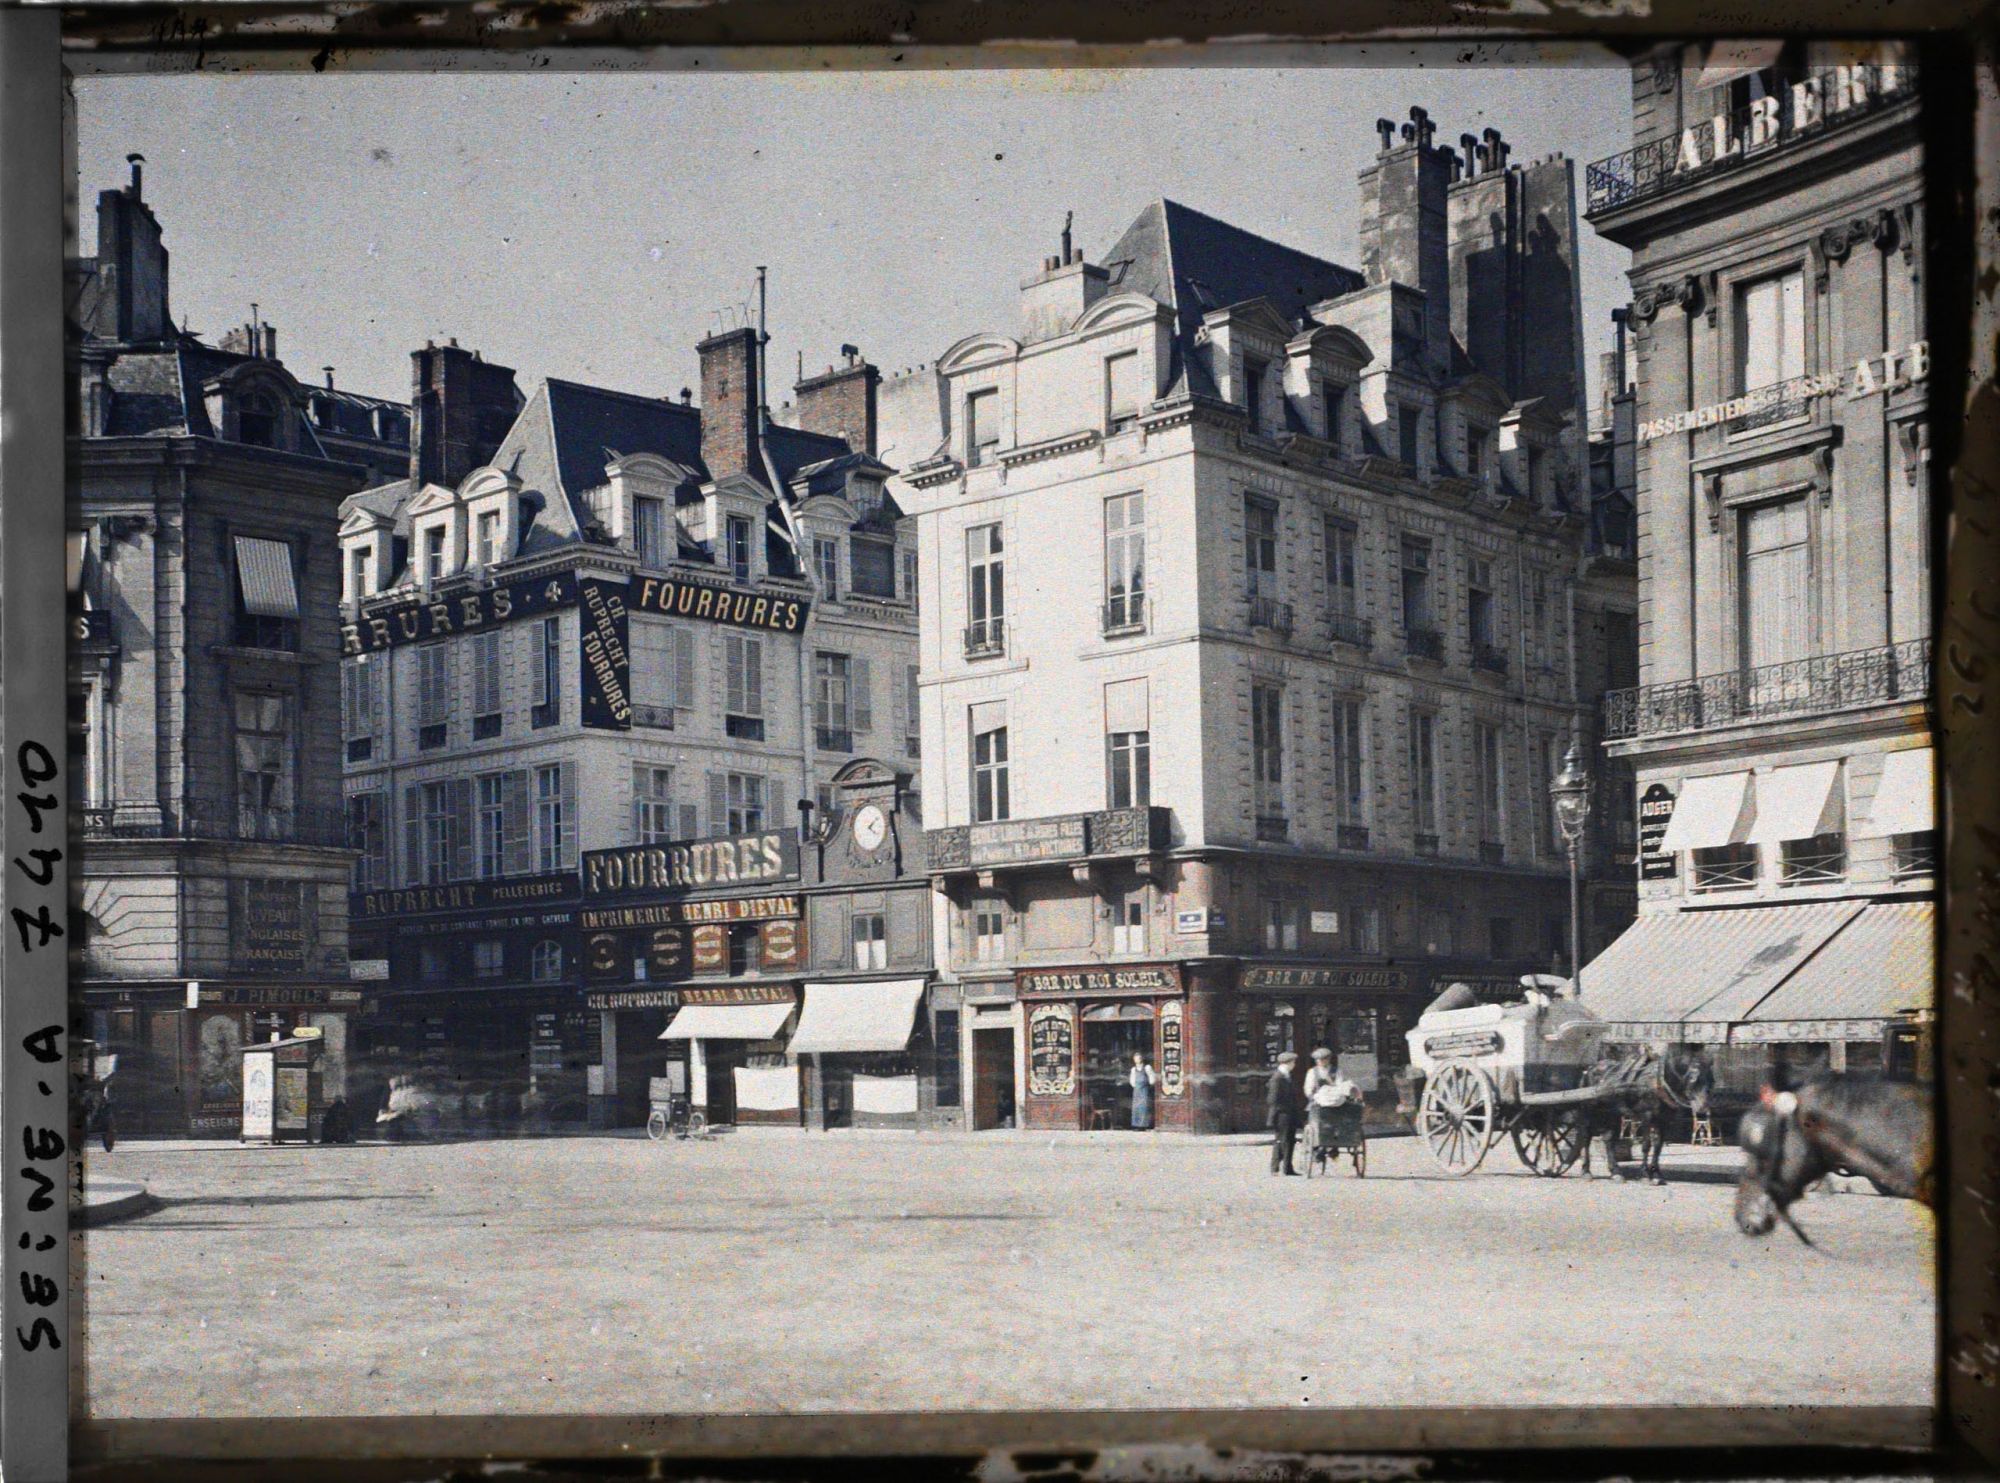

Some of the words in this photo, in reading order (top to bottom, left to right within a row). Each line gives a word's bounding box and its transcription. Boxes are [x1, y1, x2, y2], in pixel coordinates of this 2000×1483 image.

[341, 588, 512, 653] RRURES
[584, 586, 628, 668] RUPRECHT
[641, 579, 798, 630] FOURRURES
[582, 630, 631, 721] FOURRURES
[10, 740, 65, 953] 7410
[587, 835, 782, 893] FOURRURES
[365, 886, 475, 914] RUPRECHT
[493, 882, 562, 900] PELLETERIES
[582, 904, 672, 929] IMPRIMERIE
[682, 901, 730, 921] HENRI
[609, 990, 679, 1009] RUPRECHT
[1033, 975, 1058, 991] BAR
[1062, 974, 1082, 990] DU
[1087, 973, 1111, 989] ROI
[1115, 971, 1162, 988] SOLEIL
[1264, 971, 1291, 984] BAR
[1300, 971, 1315, 984] DU
[1349, 972, 1390, 986] SOLEIL
